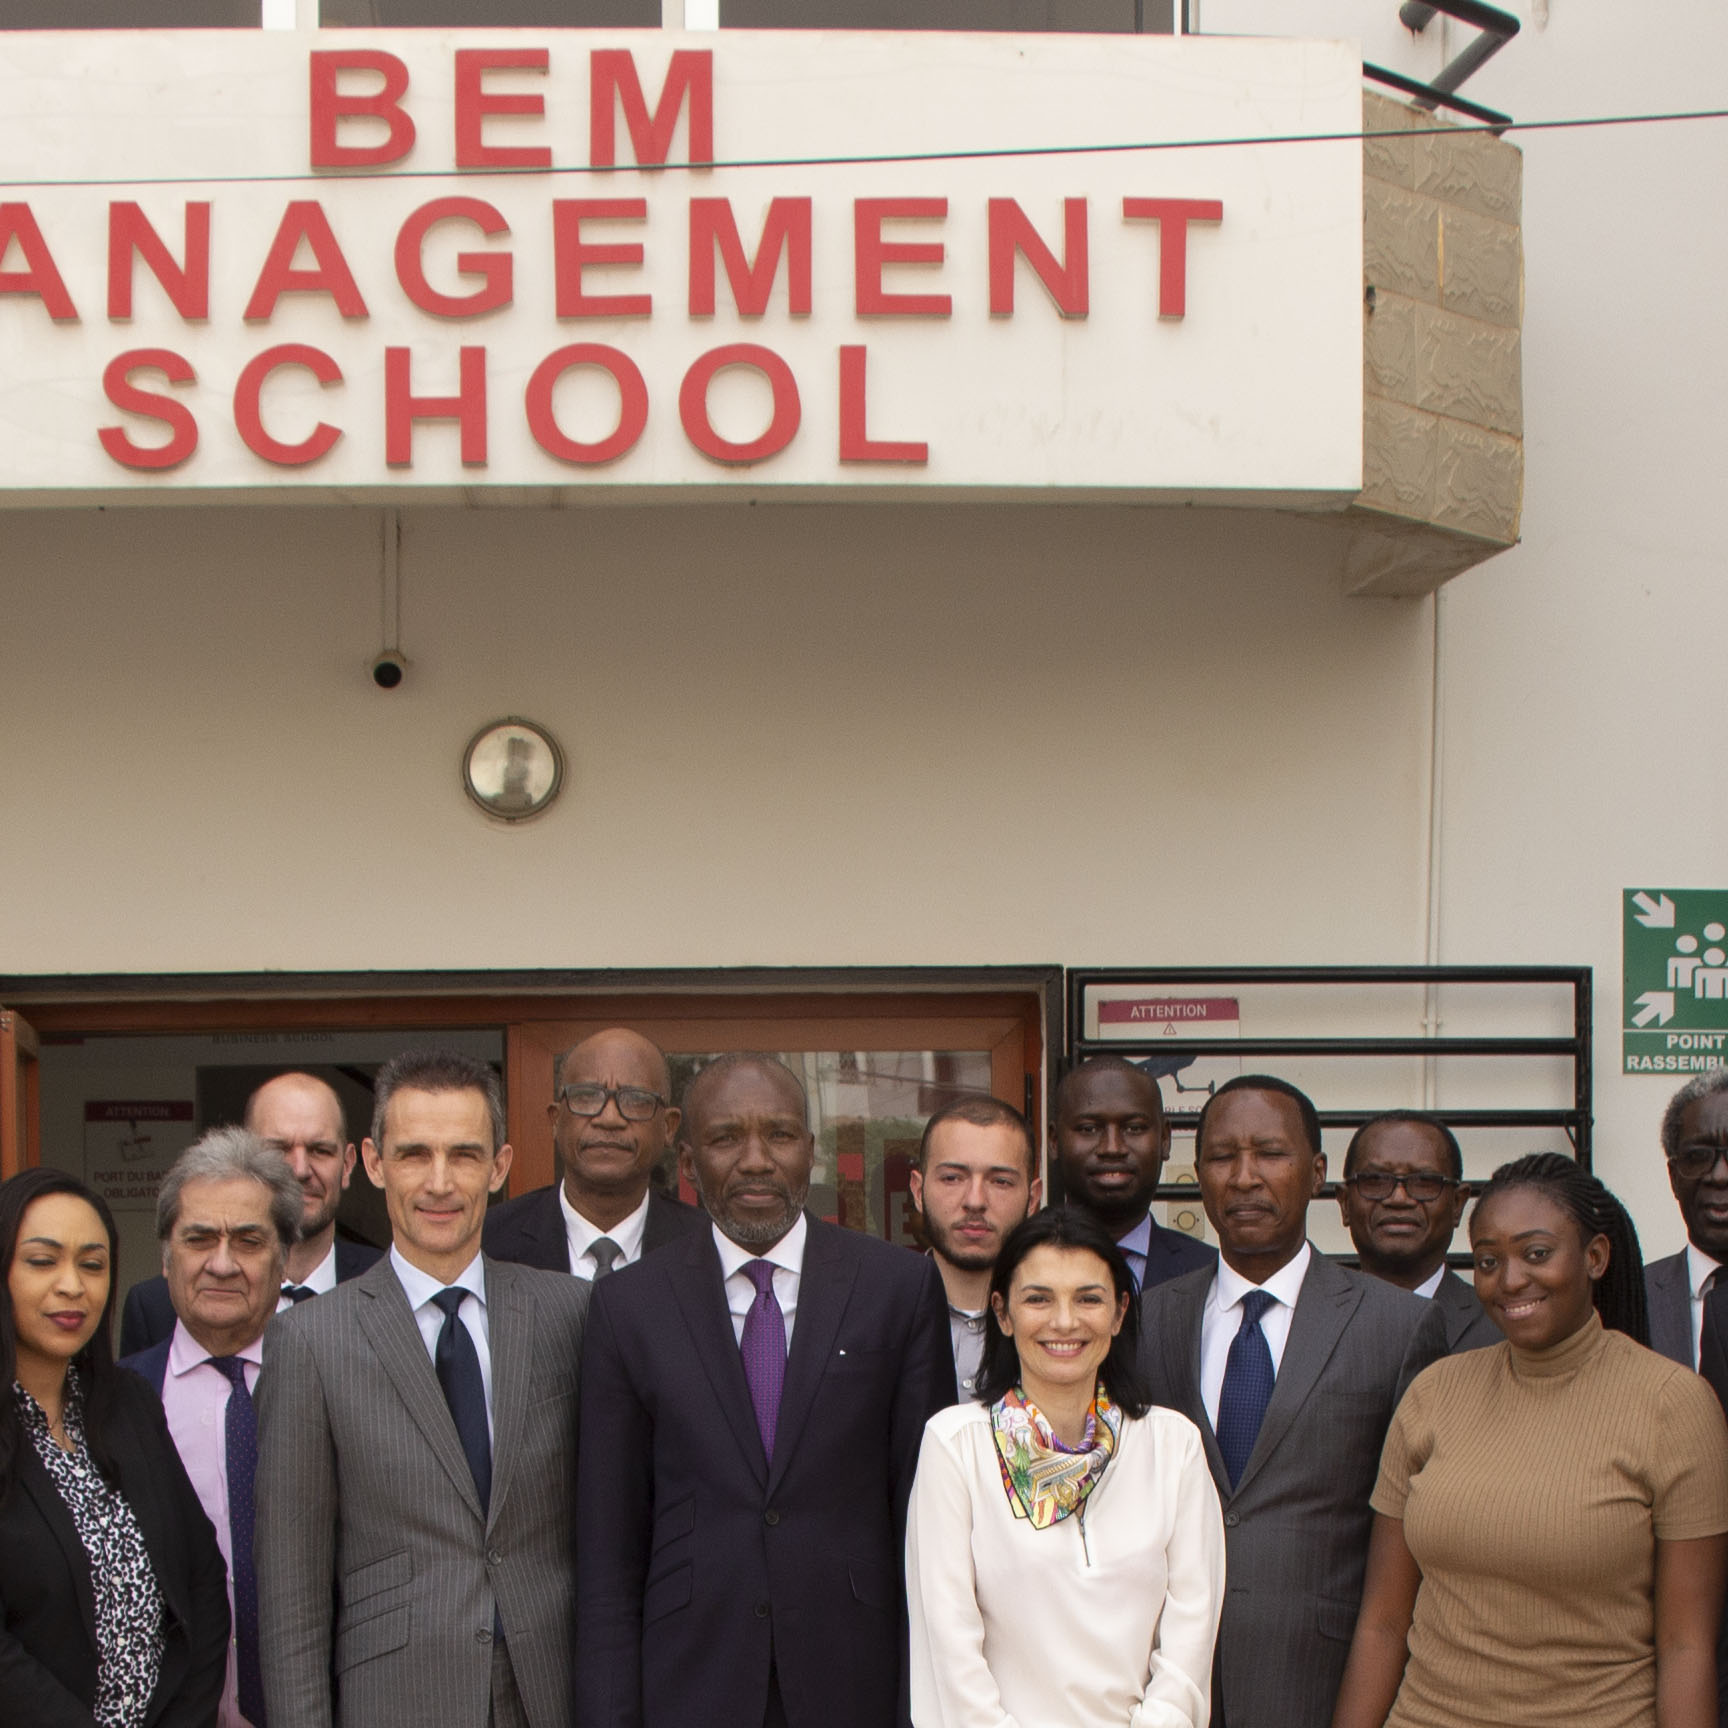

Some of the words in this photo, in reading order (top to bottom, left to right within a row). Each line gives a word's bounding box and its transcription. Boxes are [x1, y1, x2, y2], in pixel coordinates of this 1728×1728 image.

[309, 49, 714, 173] BEM
[97, 343, 929, 470] SCHOOL
[1130, 1004, 1207, 1018] ATTENTION
[1666, 1034, 1726, 1050] POINT
[105, 1105, 169, 1118] ATTENTION
[94, 1171, 123, 1183] PORT
[127, 1171, 144, 1183] DU
[104, 1187, 160, 1199] OBLIGATO
